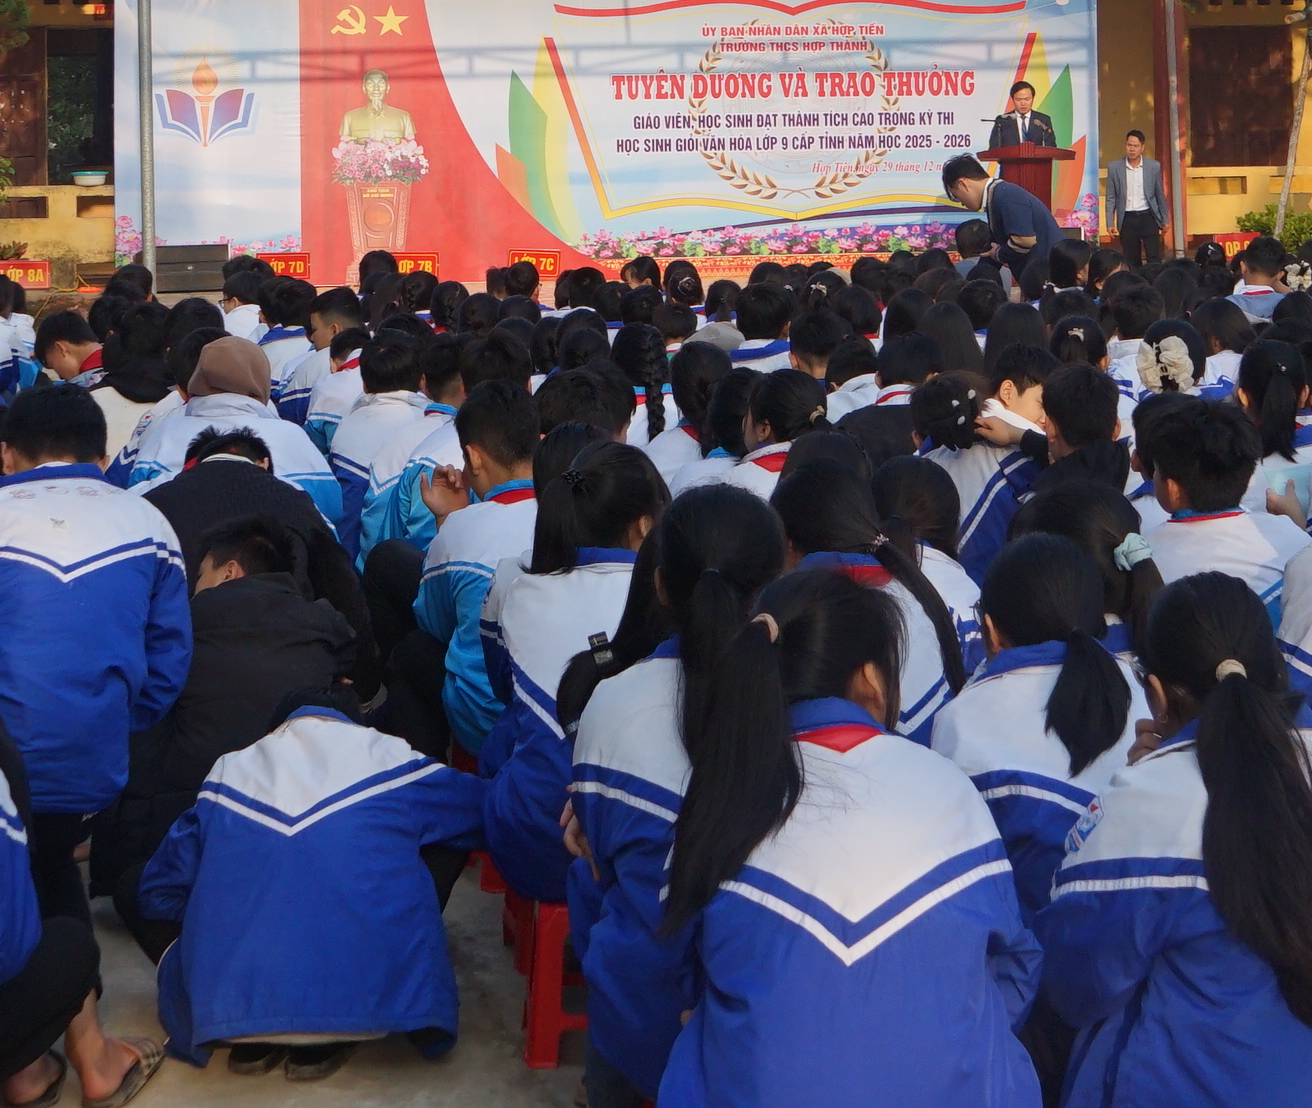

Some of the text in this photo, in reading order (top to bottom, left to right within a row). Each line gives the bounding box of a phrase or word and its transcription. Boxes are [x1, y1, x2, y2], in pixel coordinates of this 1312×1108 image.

[702, 22, 884, 38] ỦY BAN NHÂN DÂN XÃ HỢP TIẾN
[719, 39, 868, 53] TRƯỜNG THCS HỢP THÀNH
[611, 64, 975, 100] TUYÊN DƯƠNG VÀ TRAO THƯỞNG
[633, 109, 954, 131] GIÁO VIÊN, HỌC SINH ĐẠT THÀNH TÍCH CAO TRONG KỲ THI
[616, 138, 640, 156] HỌC
[644, 138, 672, 152] SINH
[675, 133, 699, 152] GIỎI
[702, 134, 725, 151] VĂN
[729, 133, 752, 151] HÓA
[756, 133, 778, 151] LỚP
[781, 136, 788, 150] 9
[792, 131, 815, 150] CẤP
[818, 131, 844, 149] TỈNH
[848, 132, 874, 149] NĂM
[878, 134, 901, 152] HỌC
[904, 134, 932, 149] 2025
[943, 134, 971, 148] 2026
[882, 161, 893, 172] 29
[895, 161, 920, 174] tháng
[923, 161, 934, 171] 12
[288, 261, 304, 273] 7D
[417, 259, 432, 272] 7B
[539, 257, 554, 271] 7C
[27, 269, 45, 282] 8A
